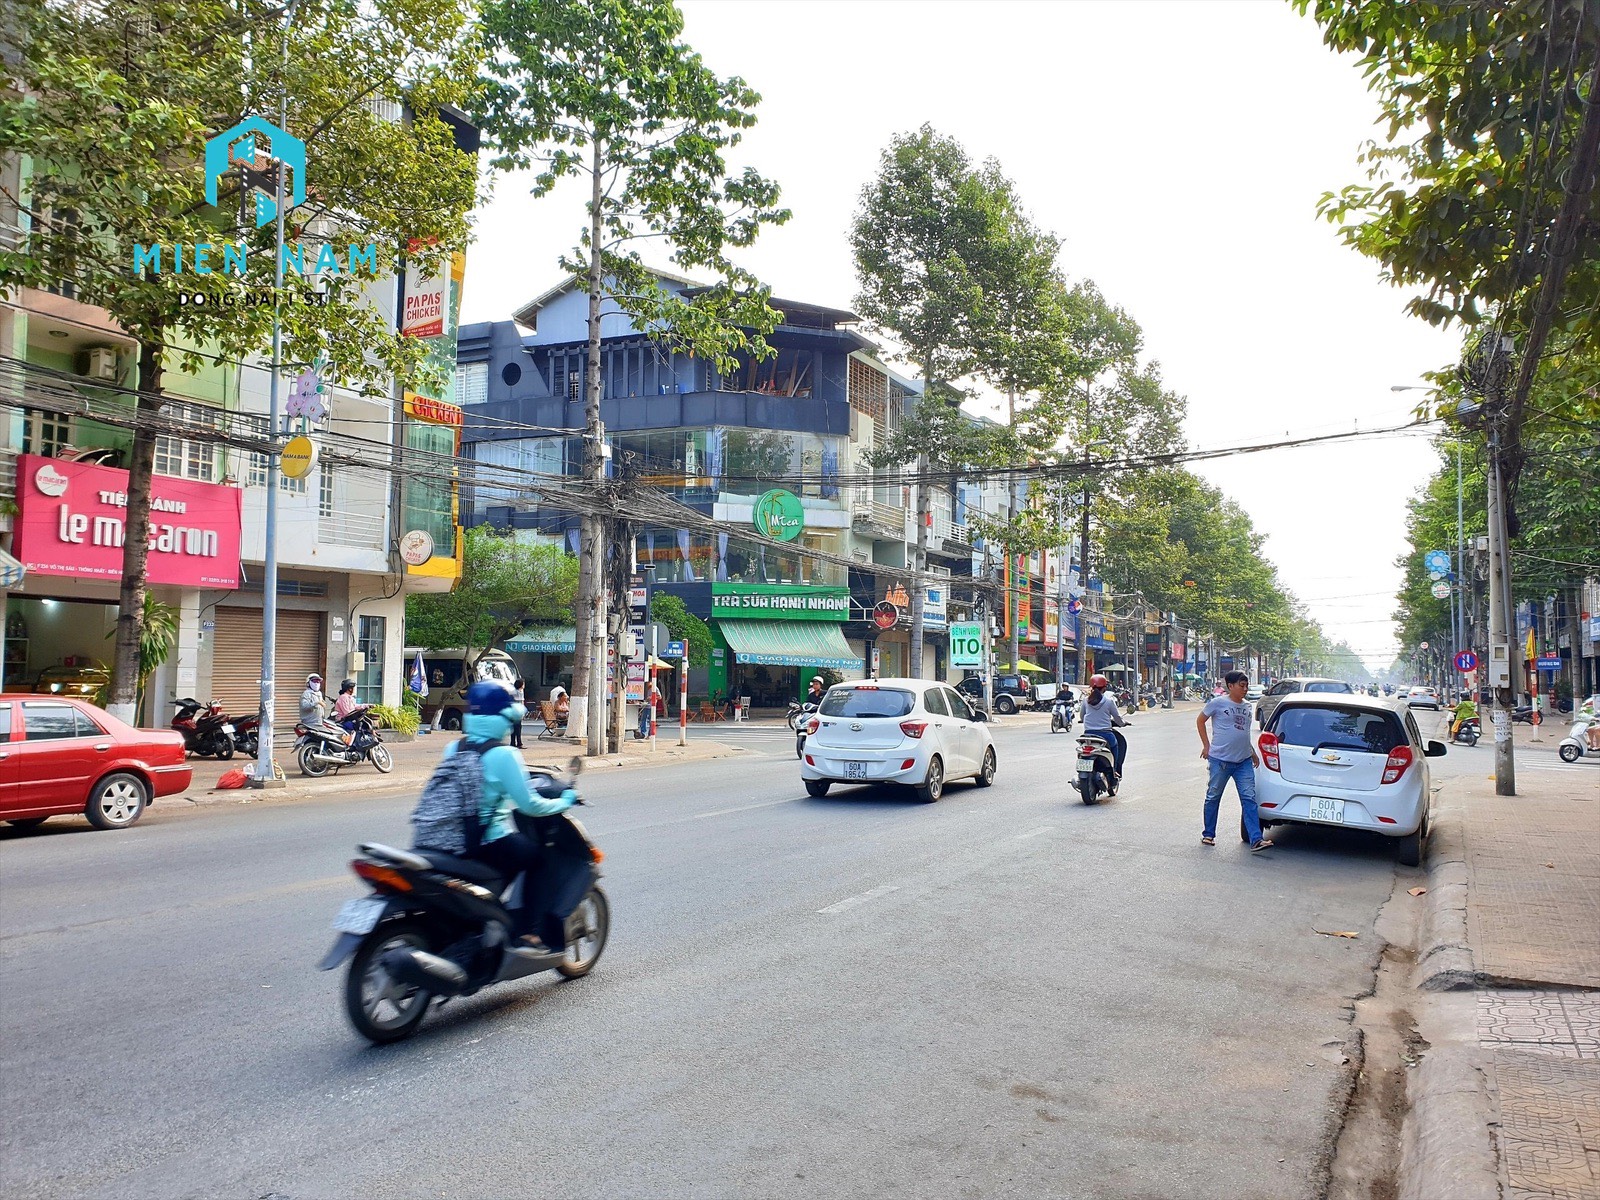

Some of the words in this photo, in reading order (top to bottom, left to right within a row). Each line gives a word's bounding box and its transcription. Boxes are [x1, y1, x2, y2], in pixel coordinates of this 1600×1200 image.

[406, 306, 441, 321] CHICKEN
[413, 396, 463, 424] CHICKEN
[149, 496, 187, 514] ÁNH
[59, 503, 88, 544] le
[92, 516, 218, 557] mcaron
[712, 590, 740, 607] TRÀ
[770, 596, 806, 612] HẠNH
[952, 638, 980, 655] ITO
[848, 762, 861, 770] 60A
[1318, 799, 1336, 811] 60A
[1310, 808, 1342, 822] 564.10
